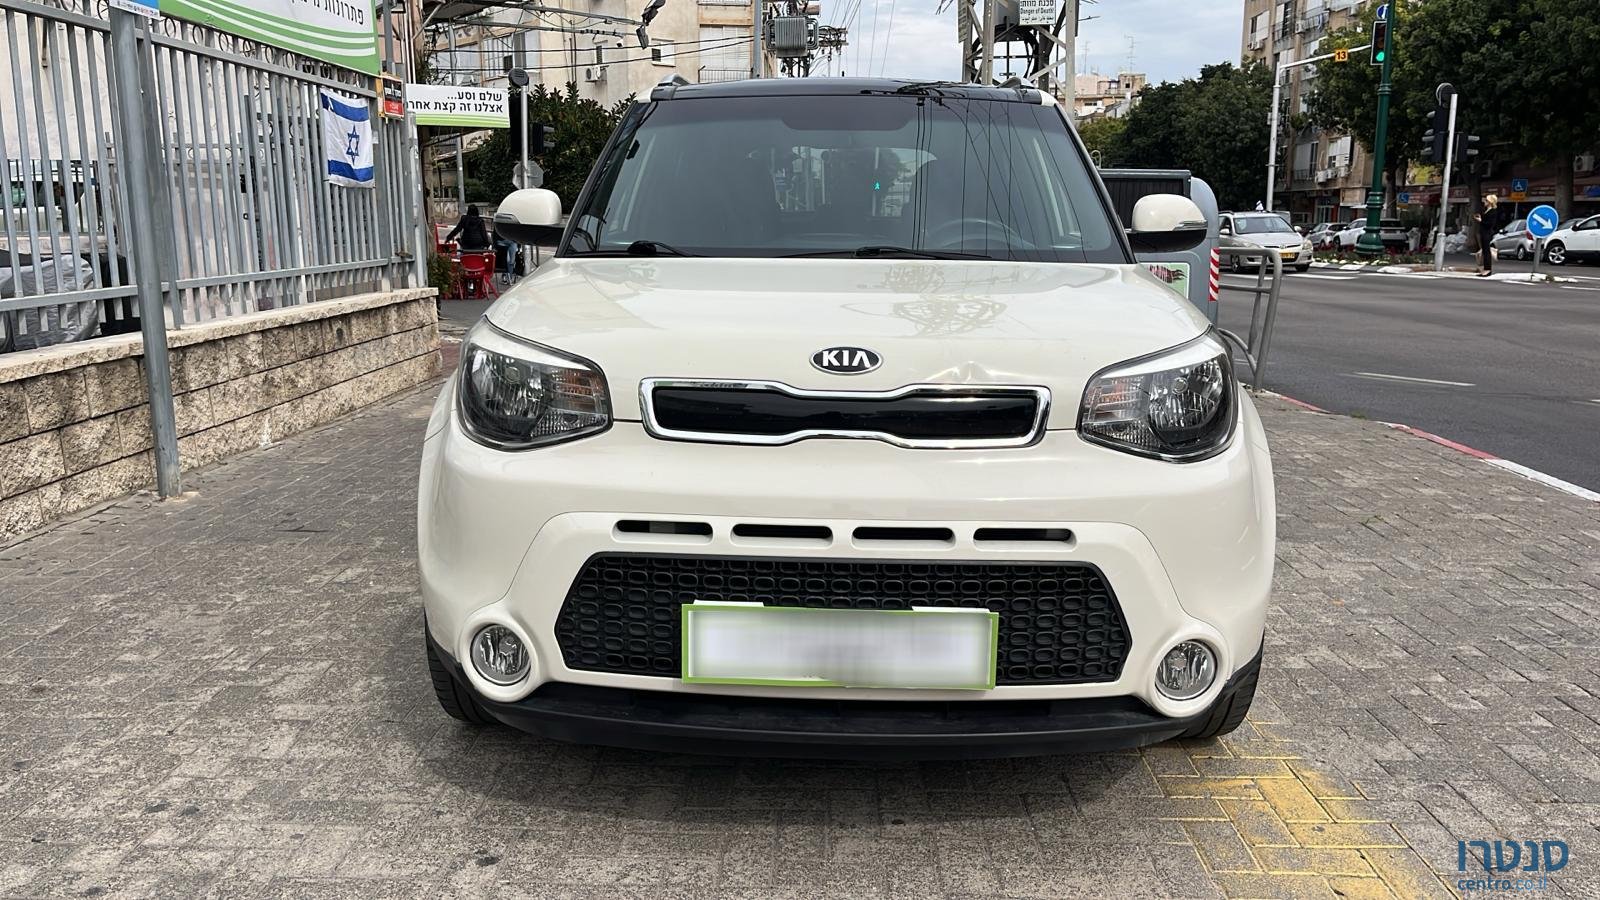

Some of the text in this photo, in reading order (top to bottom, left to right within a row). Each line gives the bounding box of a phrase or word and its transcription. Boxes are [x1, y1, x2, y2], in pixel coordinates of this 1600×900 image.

[1337, 51, 1346, 60] 13
[447, 91, 502, 102] שלם וסע...
[434, 102, 456, 113] קצת
[460, 103, 472, 112] זה
[475, 102, 503, 113] אצלנו
[822, 350, 871, 367] KIA
